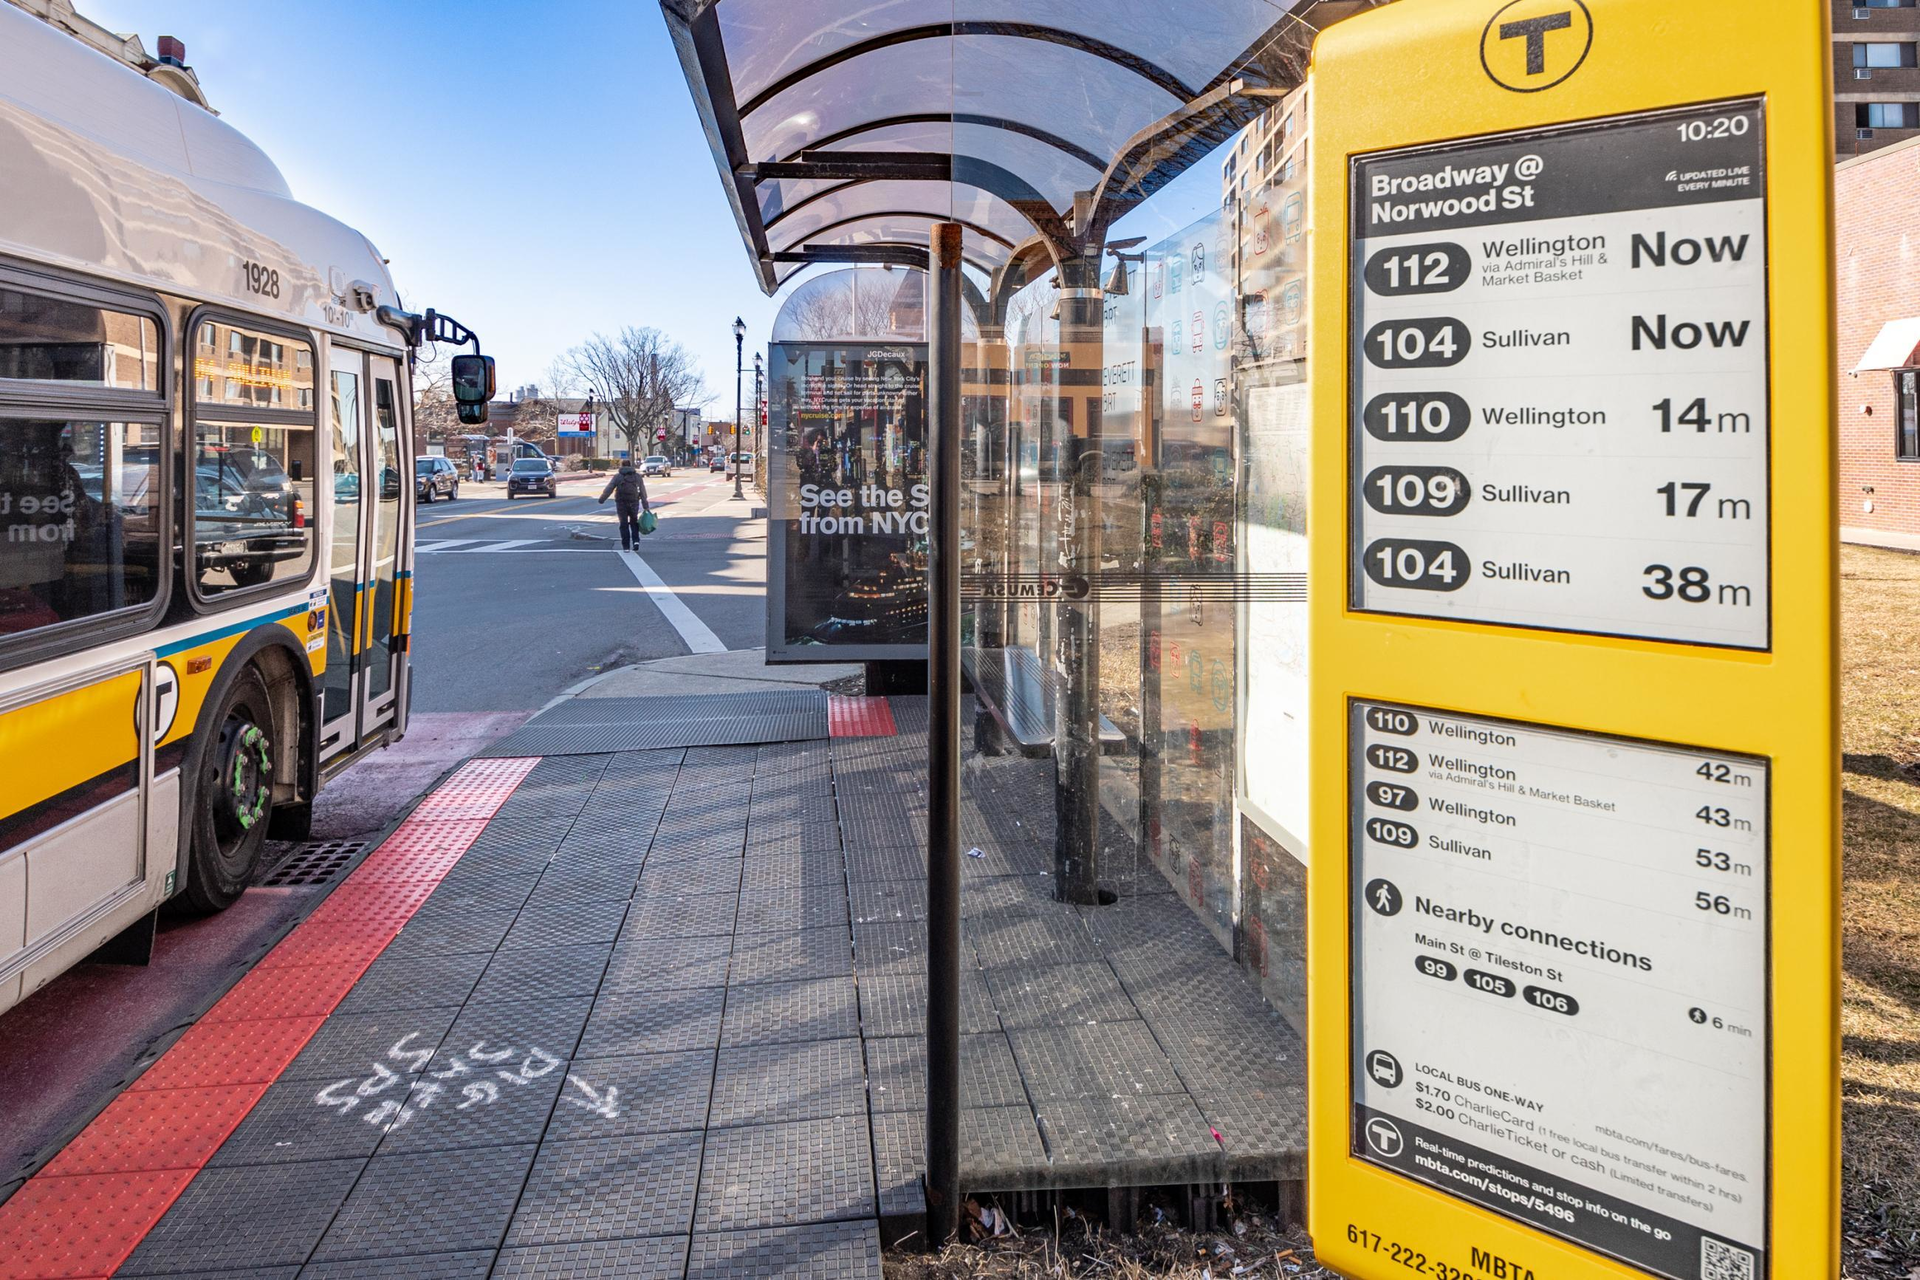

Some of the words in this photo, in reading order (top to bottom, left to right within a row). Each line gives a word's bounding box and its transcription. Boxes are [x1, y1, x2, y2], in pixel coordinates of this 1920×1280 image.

[1500, 11, 1571, 76] T
[1677, 115, 1749, 142] 10:20
[1371, 160, 1508, 198] Broadway
[1515, 154, 1544, 182] @
[1677, 181, 1710, 192] EVERY
[1711, 176, 1750, 188] MINUTE
[1680, 168, 1726, 181] UPDATED
[1727, 165, 1750, 176] LIVE
[1371, 188, 1497, 225] Norwood
[1502, 185, 1535, 212] St
[1383, 251, 1450, 288] 112
[1482, 233, 1606, 261] Wellington
[1631, 231, 1750, 269] Now
[1482, 261, 1502, 274] via
[1504, 255, 1569, 272] Admiral's
[1571, 253, 1593, 267] Hill
[1597, 253, 1608, 266] &
[1482, 273, 1530, 287] Market
[1534, 269, 1583, 284] Basket
[242, 259, 280, 300] 1928
[867, 350, 906, 358] JCDecaux
[1376, 325, 1458, 361] 104
[1482, 329, 1571, 349] Sullivan
[1631, 313, 1751, 351] Now
[854, 375, 861, 383] by
[1103, 360, 1136, 387] EVERETT
[800, 412, 846, 420] nycruise.com
[1381, 400, 1451, 434] 110
[1482, 406, 1606, 429] Wellington
[800, 484, 853, 508] See
[859, 484, 904, 508] the
[1376, 473, 1456, 509] 109
[1482, 484, 1571, 505] Sullivan
[800, 511, 864, 535] from
[872, 511, 930, 535] NYC
[1376, 546, 1457, 584] 104
[1482, 560, 1571, 584] Sullivan
[1374, 711, 1410, 732] 110
[1428, 720, 1516, 747] Wellington
[1375, 748, 1409, 770] 112
[1428, 753, 1516, 781] Wellington
[1378, 786, 1406, 806] 97
[1428, 797, 1516, 827] Wellington
[1428, 770, 1443, 780] via
[1445, 773, 1495, 790] Admiral's
[1498, 781, 1515, 793] Hill
[1518, 785, 1526, 795] &
[1529, 787, 1570, 804] Market
[1574, 795, 1616, 812] Basket
[1372, 821, 1412, 845] 109
[1428, 835, 1492, 861] Sullivan
[1415, 895, 1494, 934] Nearby
[1500, 918, 1653, 972] connections
[1415, 932, 1447, 951] Main
[1450, 943, 1465, 956] St
[1468, 947, 1482, 961] @
[1485, 951, 1543, 977] Tileston
[1546, 968, 1564, 983] St
[1424, 960, 1448, 978] 99
[1473, 974, 1506, 995] 105
[1532, 990, 1569, 1013] 106
[1712, 1016, 1723, 1030] 6
[1727, 1024, 1752, 1038] min
[1415, 1062, 1454, 1084] LOCAL
[1457, 1076, 1481, 1092] BUS
[1484, 1085, 1544, 1113] ONE-WAY
[1372, 1124, 1397, 1150] T
[1415, 1081, 1451, 1102] $1.70
[1454, 1094, 1534, 1131] CharlieCard
[1549, 1128, 1570, 1145] free
[1573, 1136, 1598, 1154] local
[1600, 1144, 1621, 1162] bus
[1623, 1154, 1667, 1179] transfer
[1670, 1171, 1705, 1191] within
[1708, 1183, 1716, 1195] 2
[1718, 1187, 1743, 1204] hrs)
[1415, 1097, 1455, 1120] $2.00
[1458, 1112, 1548, 1154] CharlieTicket
[1551, 1148, 1567, 1161] or
[1570, 1154, 1606, 1175] cash
[1609, 1167, 1655, 1193] (Limited
[1657, 1183, 1714, 1213] transfers)
[1415, 1136, 1465, 1164] Real-time
[1467, 1157, 1530, 1189] predictions
[1531, 1180, 1554, 1198] and
[1556, 1190, 1584, 1210] stop
[1585, 1199, 1610, 1218] info
[1611, 1211, 1628, 1225] on
[1630, 1217, 1652, 1234] the
[1653, 1228, 1672, 1242] go
[1415, 1153, 1576, 1225] mbta.com/stops/5496
